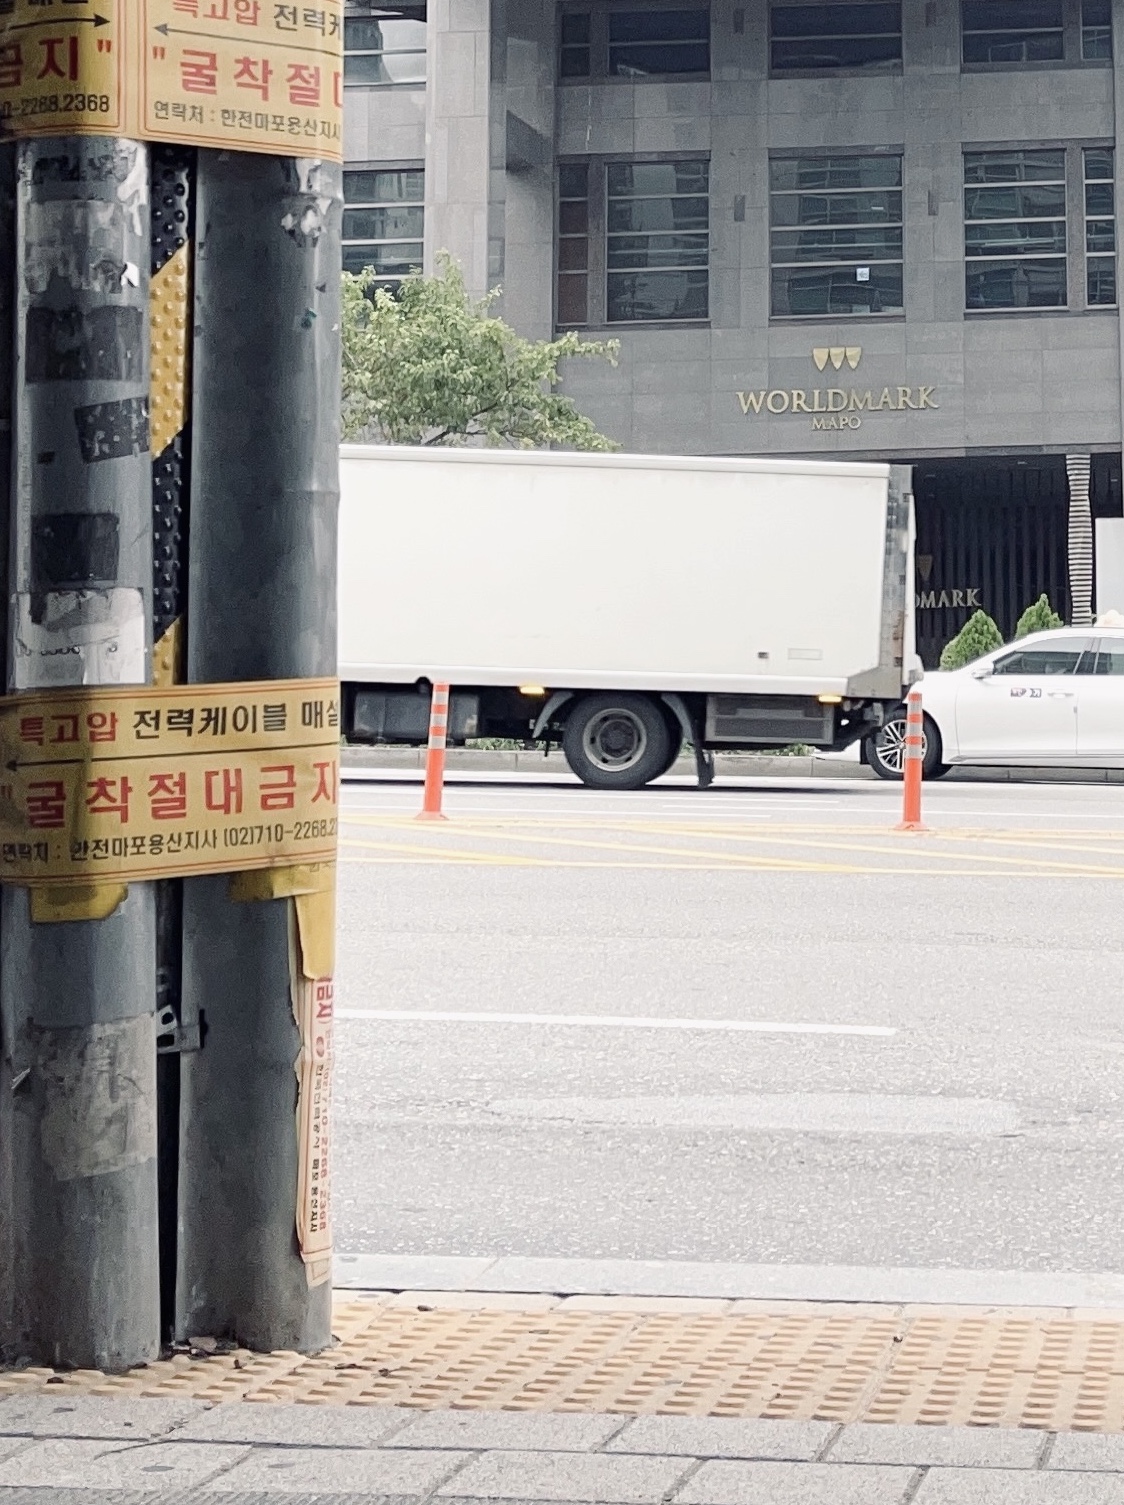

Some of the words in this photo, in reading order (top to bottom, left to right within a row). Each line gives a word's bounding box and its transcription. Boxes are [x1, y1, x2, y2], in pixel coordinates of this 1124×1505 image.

[736, 386, 940, 415] WORLDMARK
[810, 415, 862, 432] MAPO
[20, 711, 118, 746] 특고압
[133, 702, 288, 741] 전력케이블
